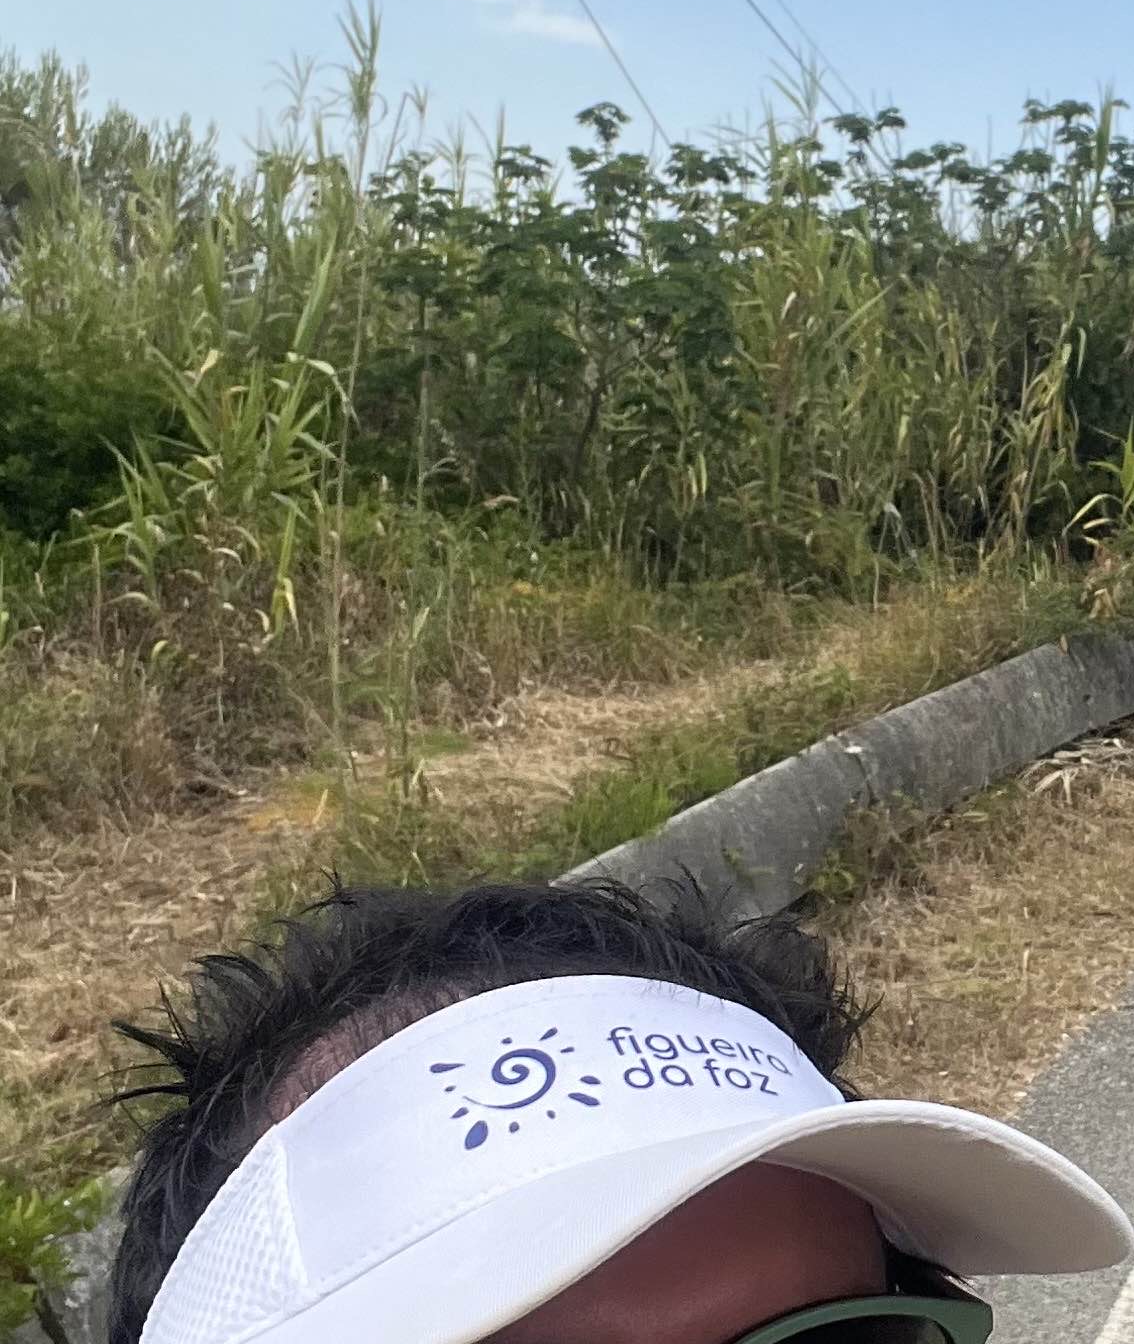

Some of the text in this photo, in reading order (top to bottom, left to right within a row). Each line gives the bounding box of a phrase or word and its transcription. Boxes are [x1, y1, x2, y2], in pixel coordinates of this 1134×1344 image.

[607, 1026, 792, 1076] figueira
[624, 1057, 779, 1096] da foz
